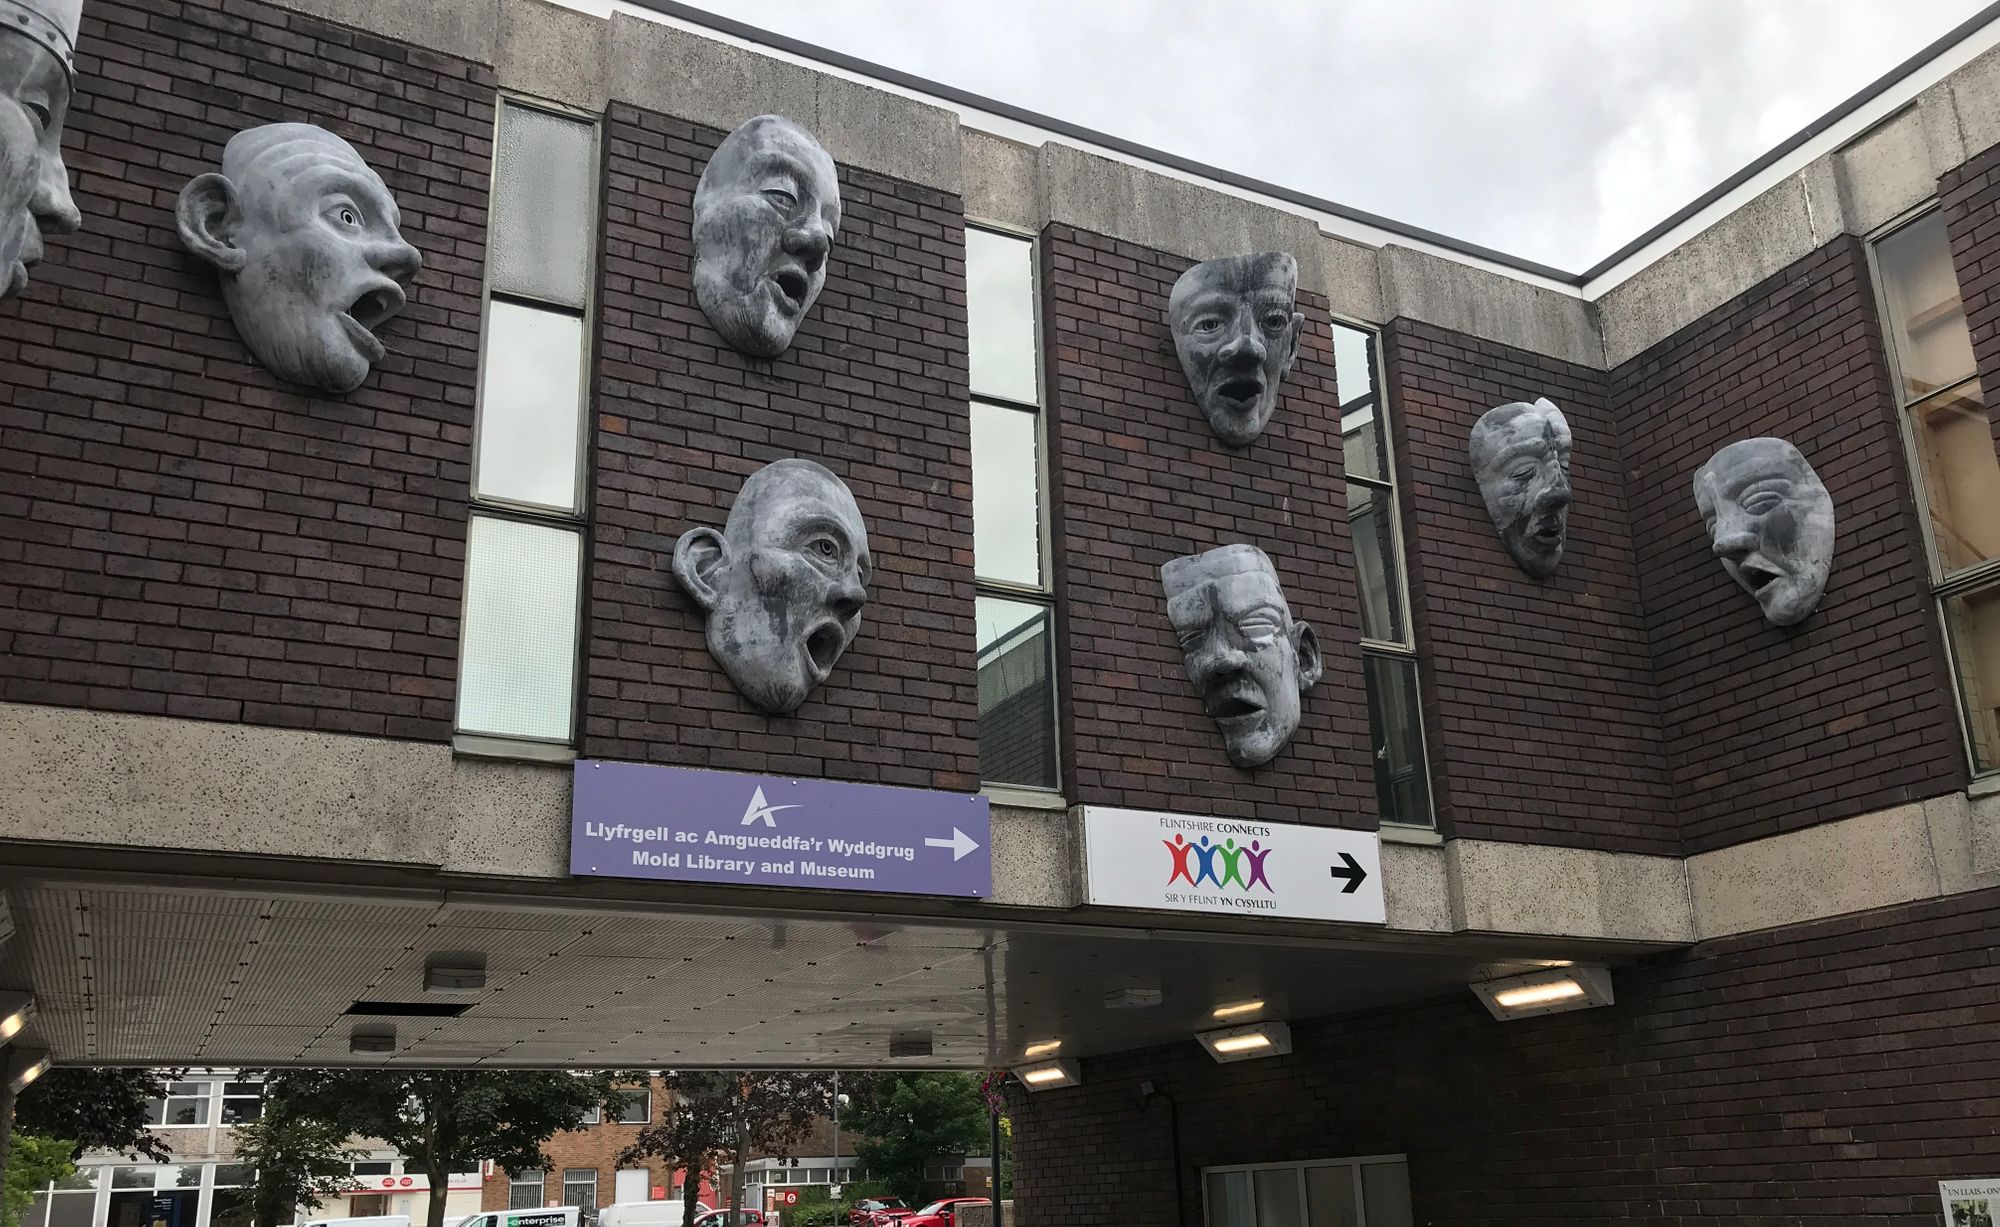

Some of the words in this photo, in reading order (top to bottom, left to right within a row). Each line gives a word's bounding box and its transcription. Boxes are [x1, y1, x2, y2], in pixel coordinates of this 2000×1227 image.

[1159, 817, 1215, 832] FLINTSHIRE
[1216, 823, 1271, 837] CONNECTS
[585, 822, 669, 842] Llyfrgell
[674, 831, 699, 844] ac
[827, 838, 915, 861] Wyddgrug
[632, 850, 680, 868] Mold
[686, 853, 755, 875] Library
[760, 860, 795, 875] and
[801, 861, 875, 880] Museum
[1164, 893, 1179, 903] SIR
[1180, 893, 1188, 903] Y
[1188, 895, 1218, 905] FFLINT
[1219, 897, 1233, 906] YN
[1235, 898, 1277, 910] CYSYLLTU
[510, 1216, 565, 1226] enterprise
